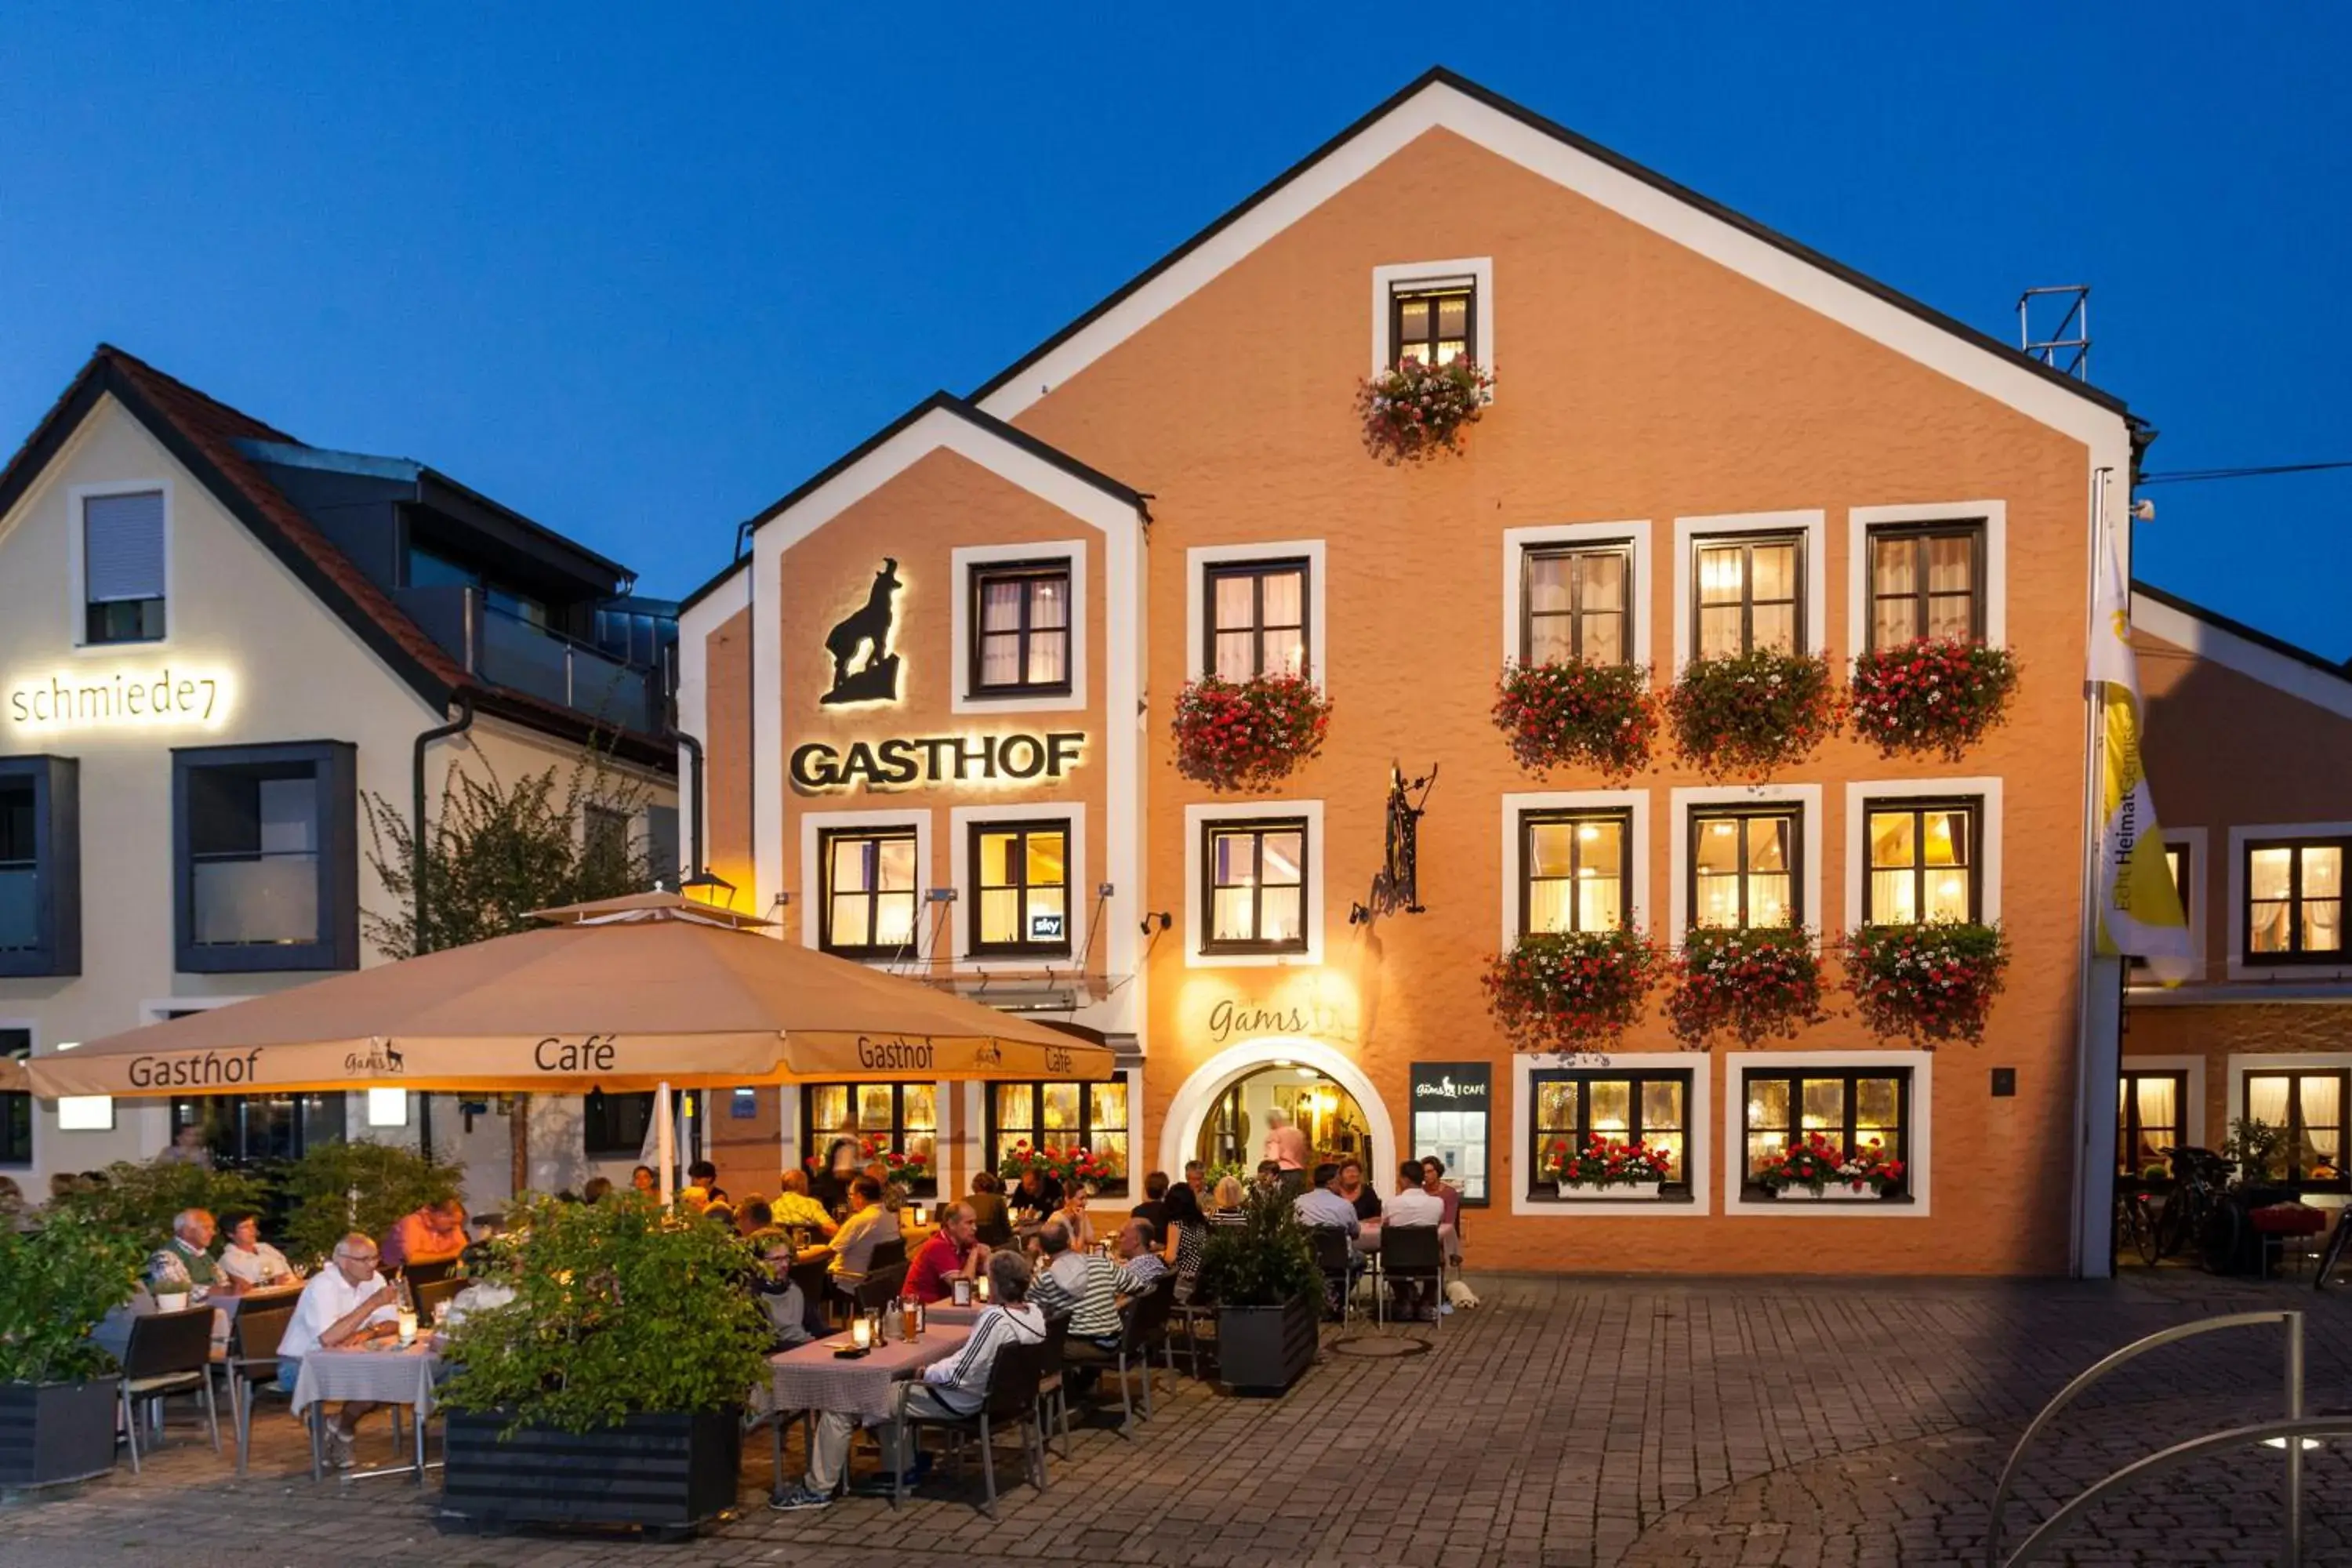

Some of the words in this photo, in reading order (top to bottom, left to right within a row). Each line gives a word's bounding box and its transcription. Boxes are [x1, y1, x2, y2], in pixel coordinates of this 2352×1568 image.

[12, 670, 216, 721] schmiede7
[790, 732, 1084, 786] GASTHOF
[1036, 918, 1059, 934] sky
[128, 1047, 264, 1087] Gasthof
[535, 1034, 616, 1071] Café
[858, 1036, 934, 1069] Gasthof
[1044, 1047, 1073, 1073] Café
